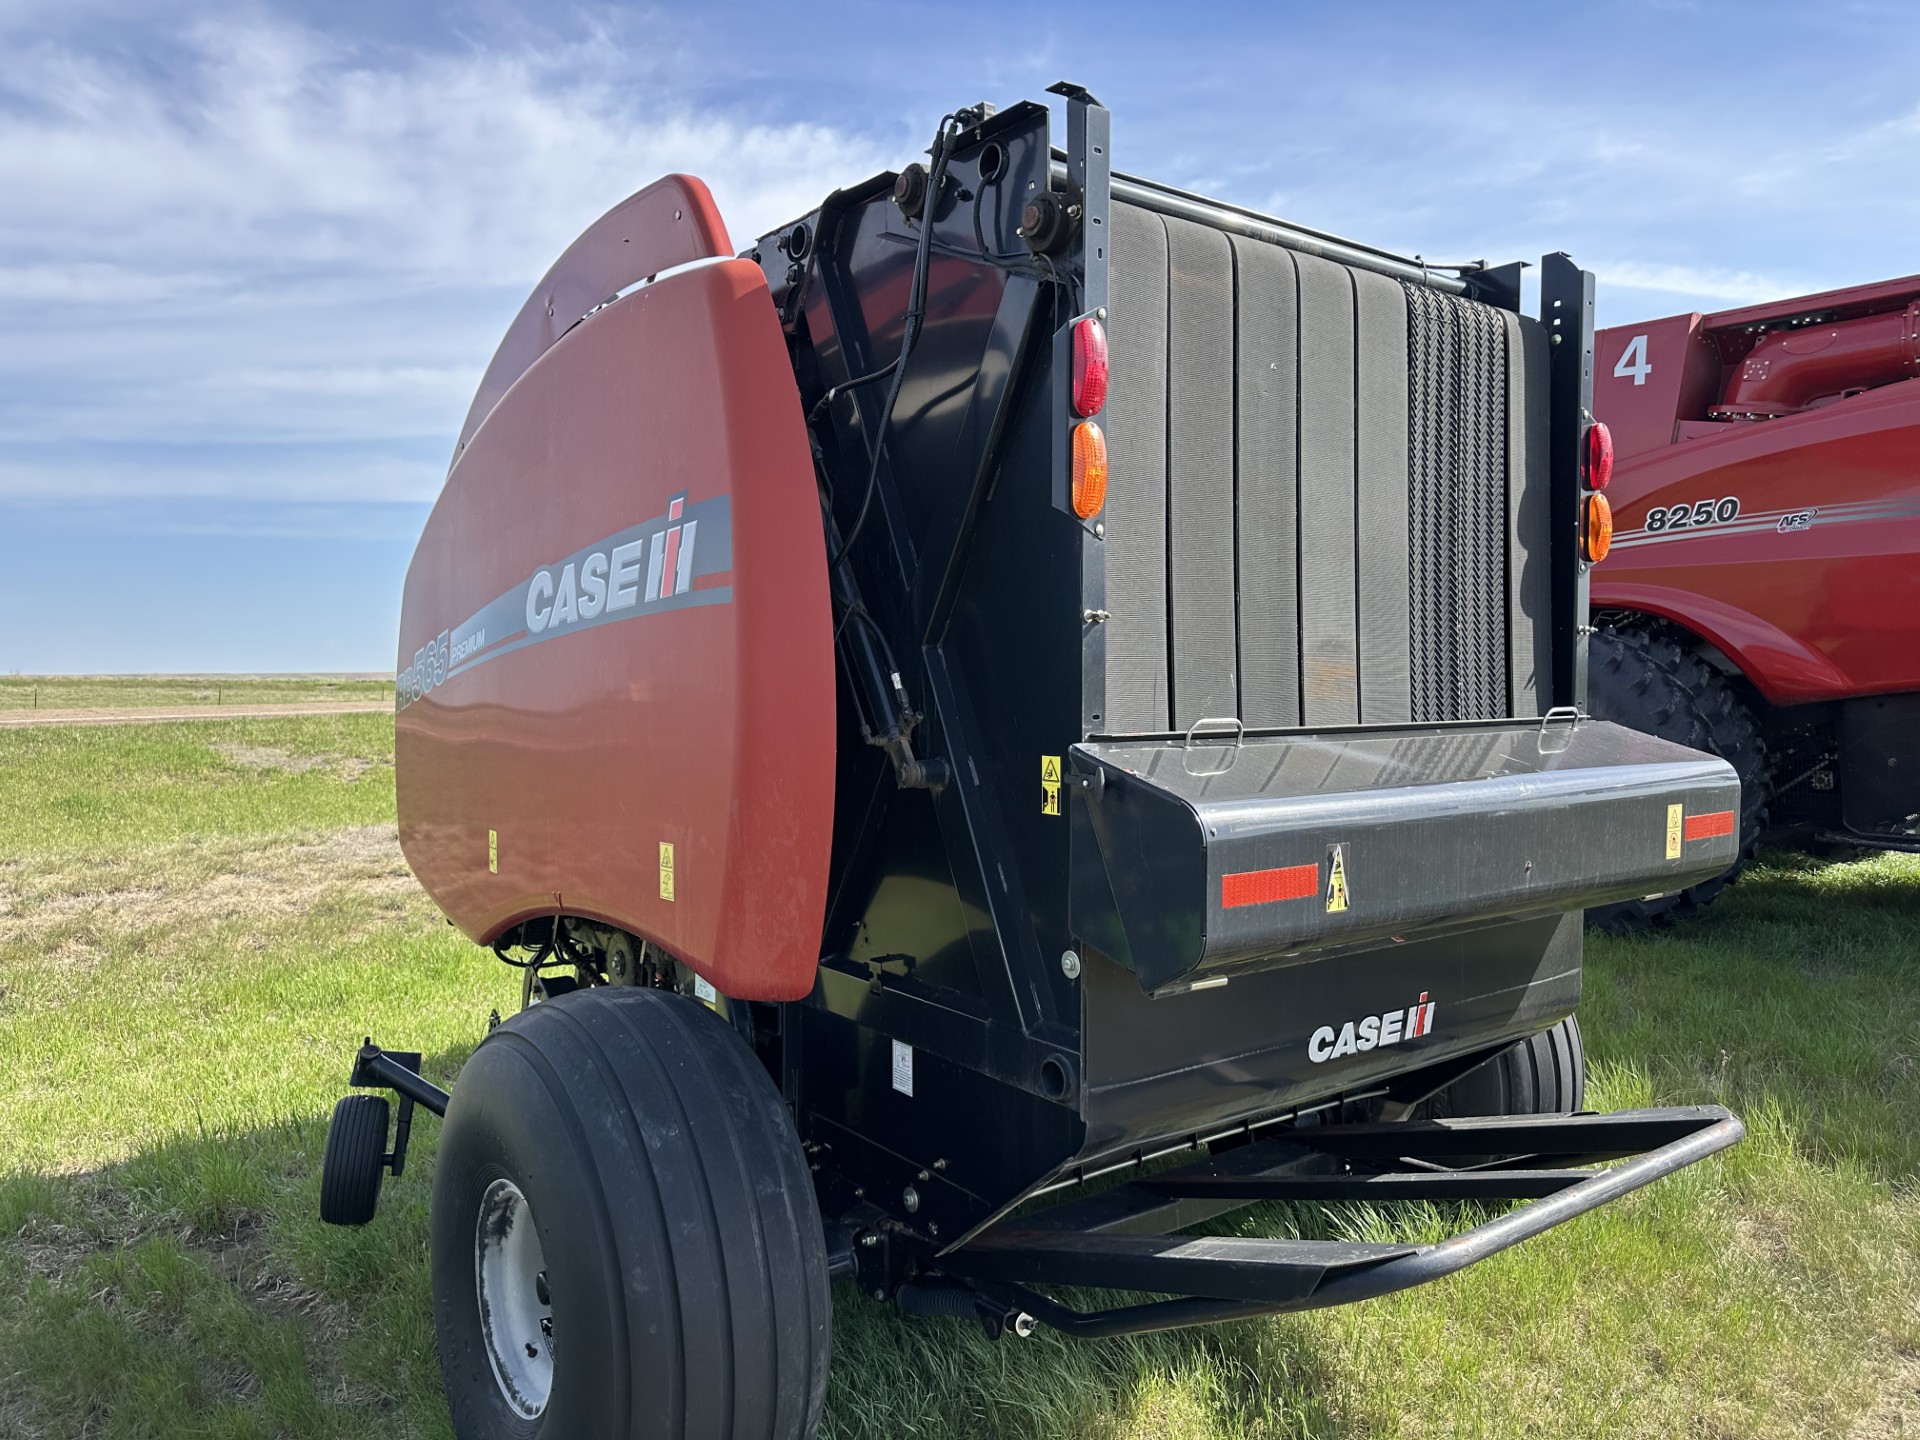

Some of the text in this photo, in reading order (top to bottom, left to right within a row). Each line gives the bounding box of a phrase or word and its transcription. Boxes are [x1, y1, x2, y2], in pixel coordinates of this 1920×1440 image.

[1613, 334, 1652, 386] 4
[1645, 496, 1740, 533] 8250
[1777, 512, 1809, 527] AFS
[451, 628, 486, 664] PREMIUM
